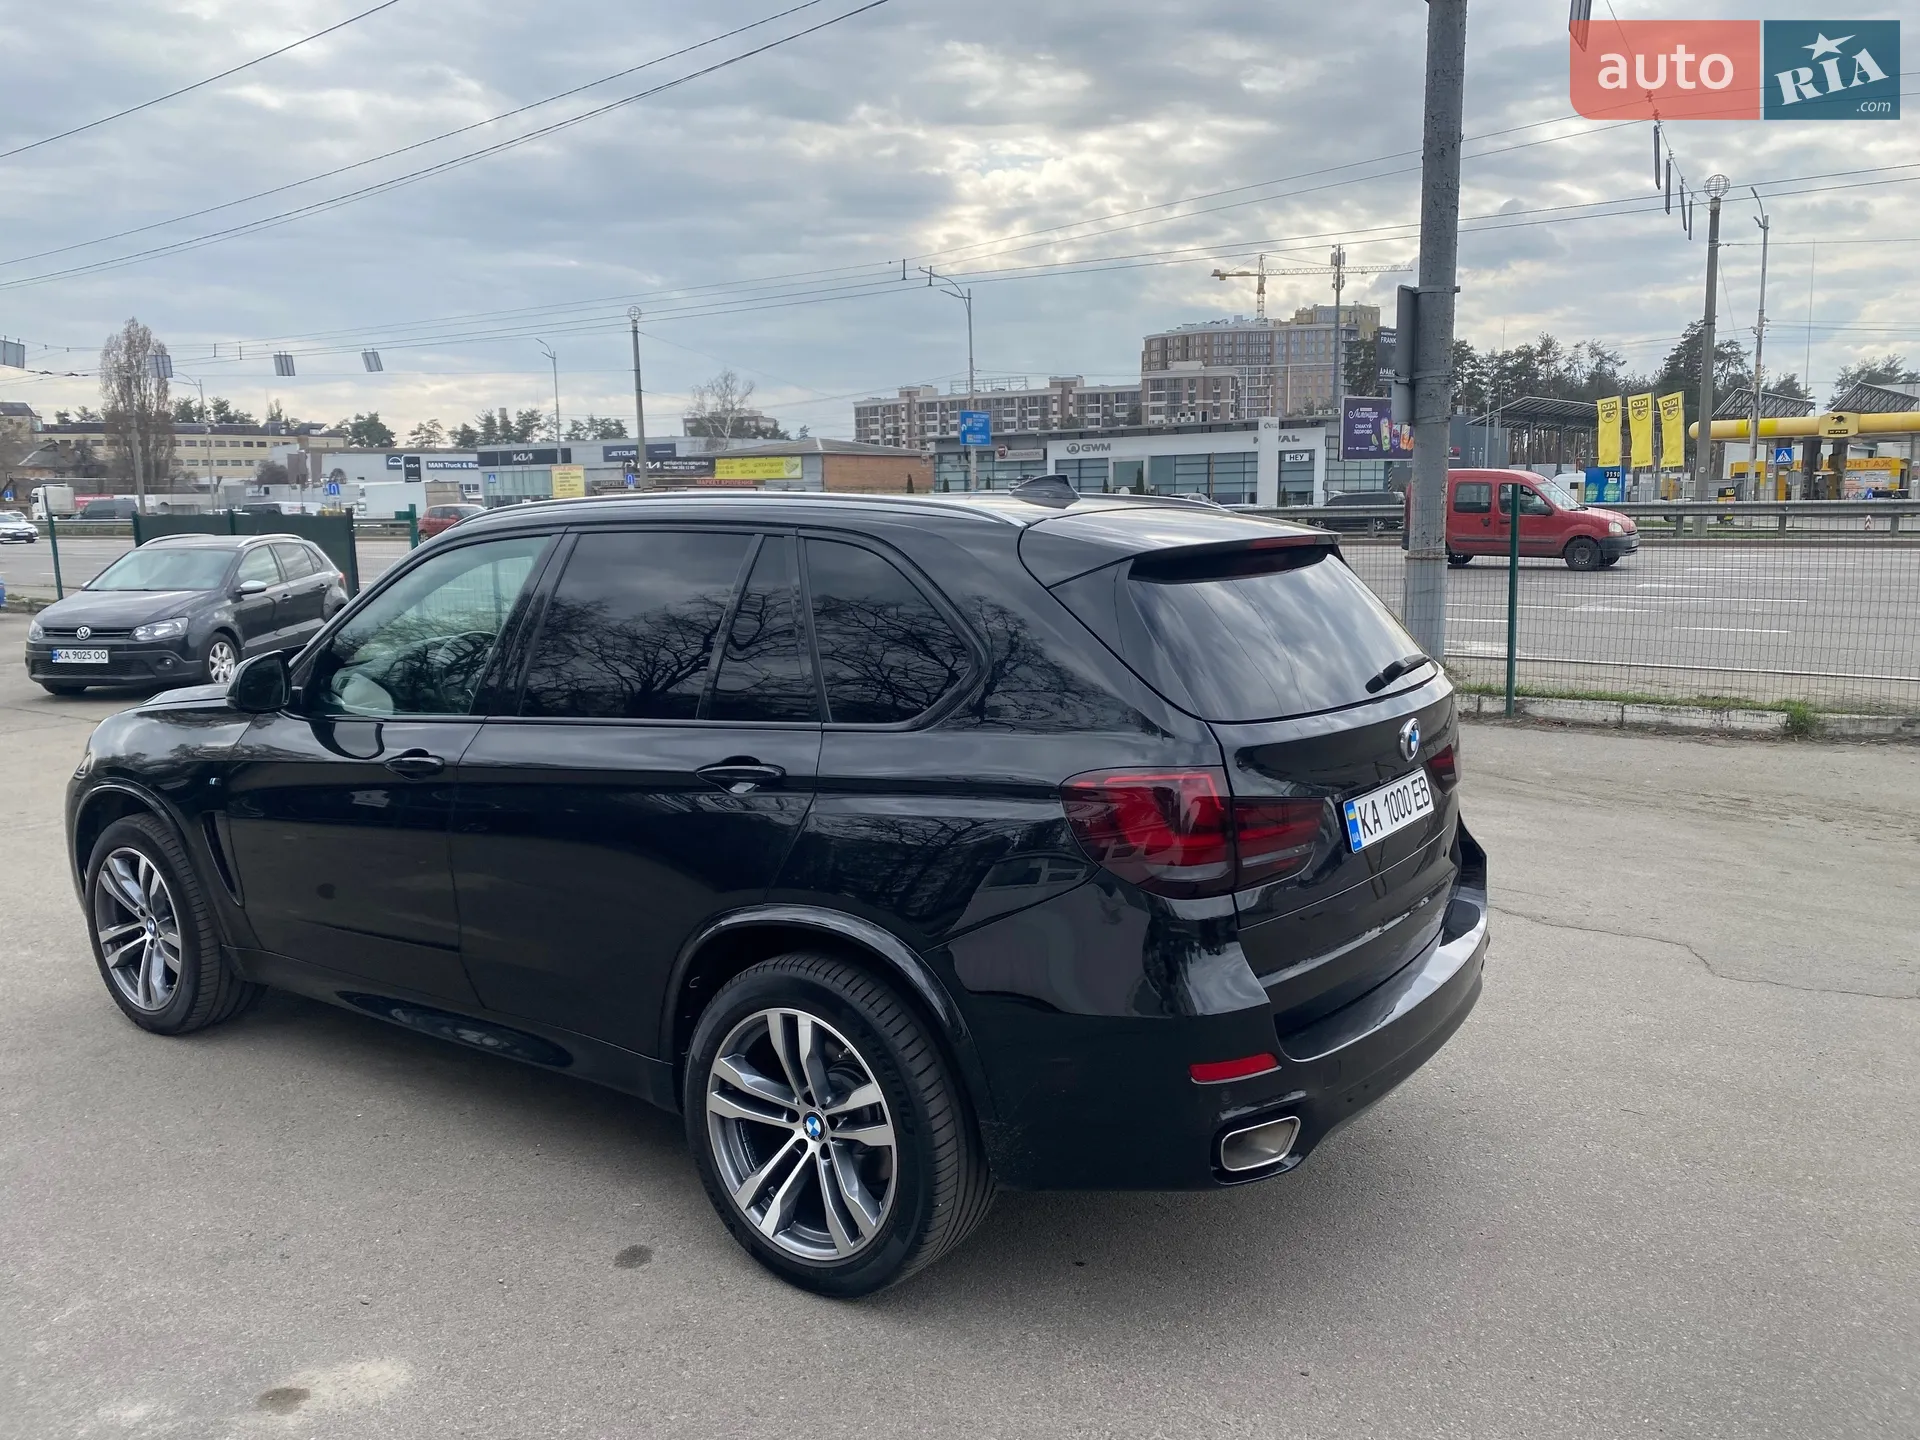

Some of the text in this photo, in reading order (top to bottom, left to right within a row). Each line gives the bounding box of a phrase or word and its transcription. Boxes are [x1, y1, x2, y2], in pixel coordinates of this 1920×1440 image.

[1082, 443, 1111, 452] GWM
[513, 453, 533, 461] KIA
[58, 650, 107, 660] KA 9025 OO
[1358, 776, 1430, 839] KA 1000 EB
